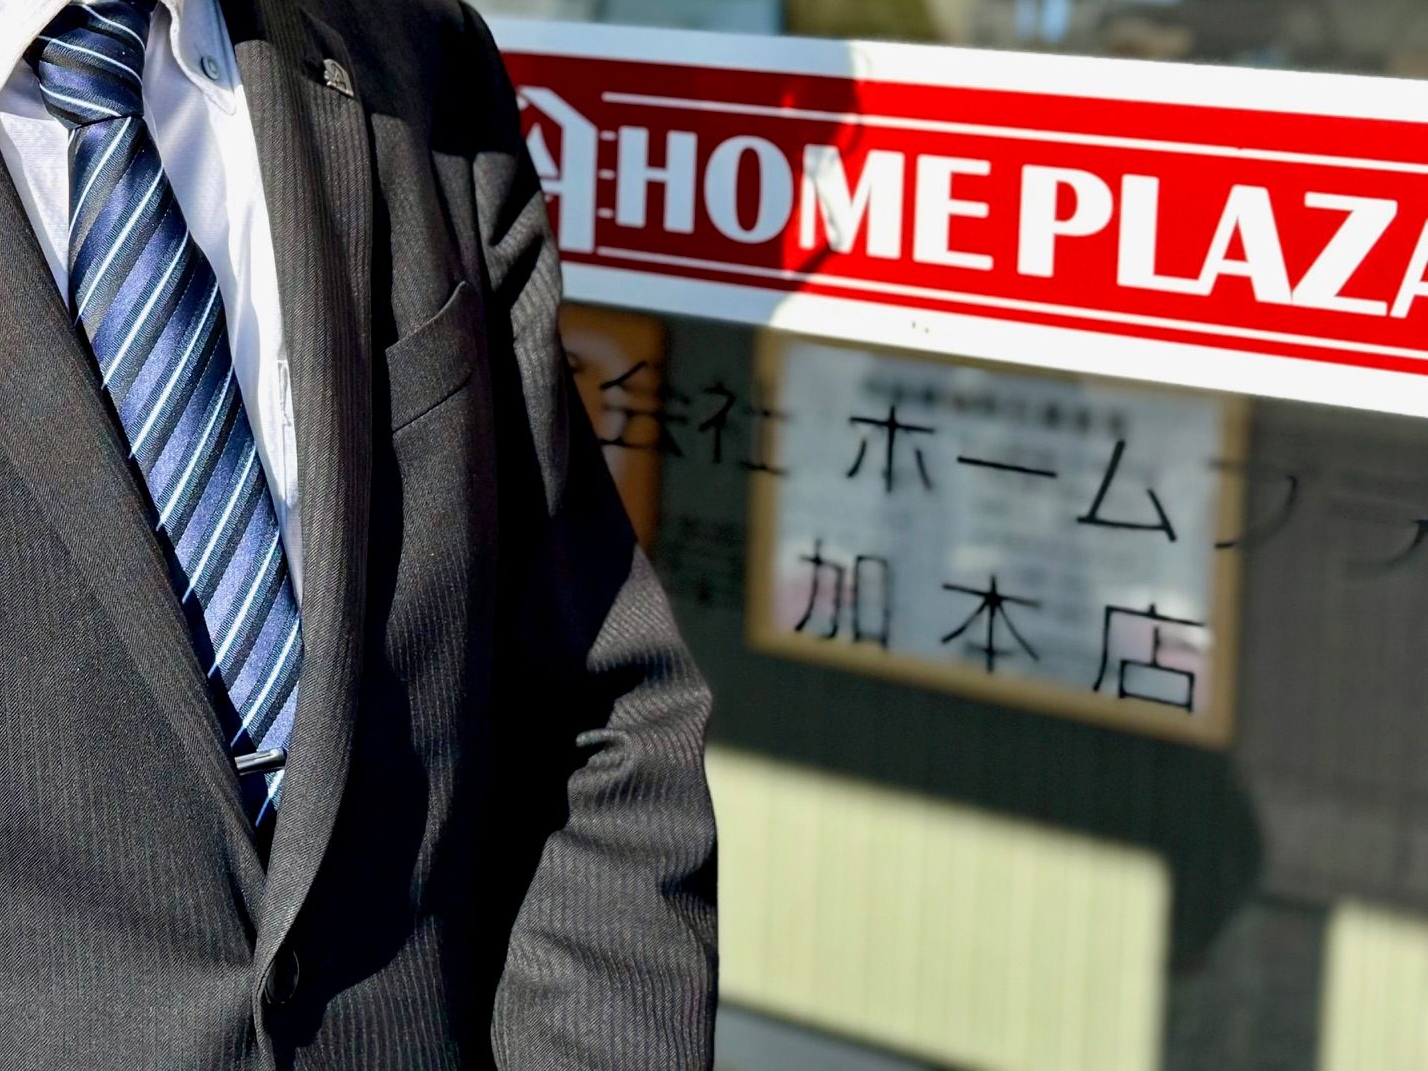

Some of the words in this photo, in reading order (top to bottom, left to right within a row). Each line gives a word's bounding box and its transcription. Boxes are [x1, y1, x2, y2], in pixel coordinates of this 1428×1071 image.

[616, 126, 994, 271] HOME
[669, 514, 1206, 711] 加本店
